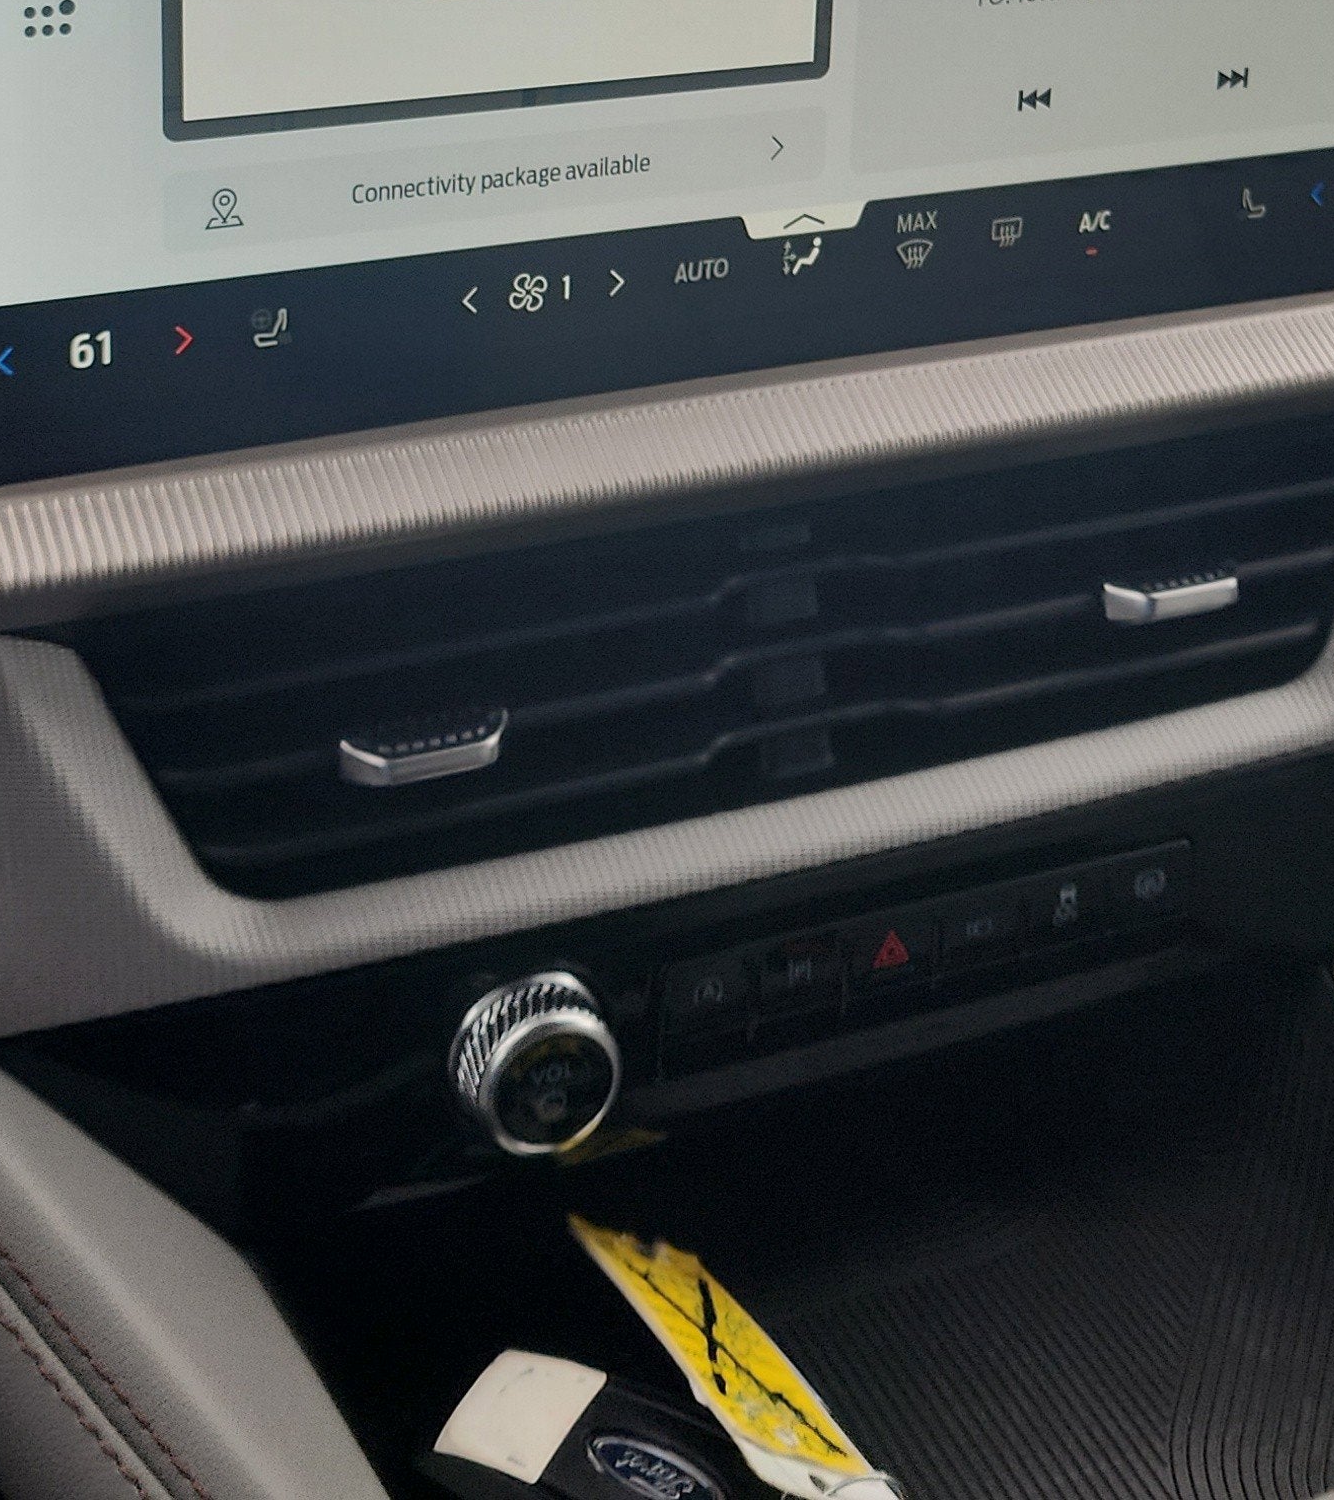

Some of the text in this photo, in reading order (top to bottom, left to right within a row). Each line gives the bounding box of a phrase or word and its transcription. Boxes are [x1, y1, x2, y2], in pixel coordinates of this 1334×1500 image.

[351, 153, 651, 205] Connectivity package available
[896, 210, 938, 233] MAX
[1078, 209, 1111, 233] A/C
[674, 257, 730, 284] AUTO
[562, 274, 571, 300] 1
[70, 330, 111, 369] 61
